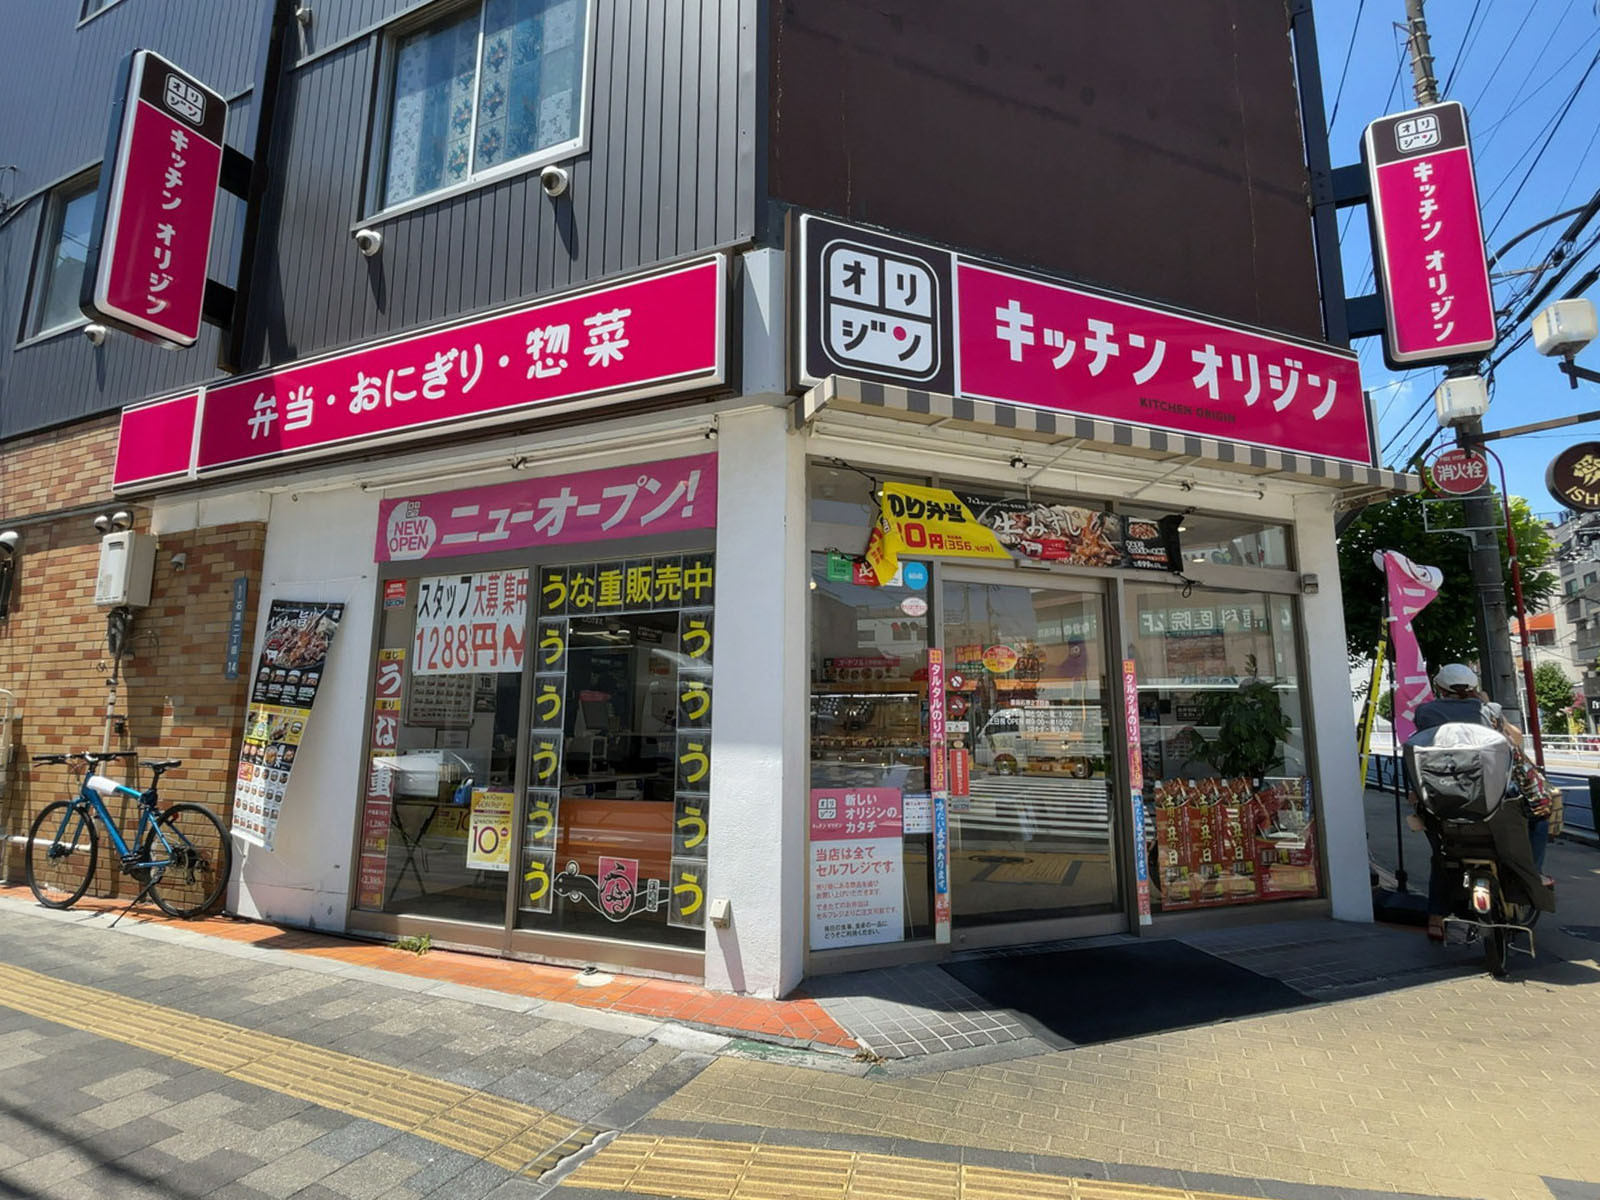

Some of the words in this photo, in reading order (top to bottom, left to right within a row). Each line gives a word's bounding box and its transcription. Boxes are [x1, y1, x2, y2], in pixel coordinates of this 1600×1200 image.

[161, 129, 190, 211] キッチン
[1412, 161, 1443, 242] キッチン
[146, 222, 177, 315] オリジン
[1424, 250, 1455, 342] オリジン
[995, 299, 1166, 386] キッチン
[1190, 344, 1337, 421] オリジン
[1139, 398, 1193, 415] KITCHEN
[1196, 408, 1236, 424] ORIGIN
[1436, 461, 1485, 482] 消火栓
[1565, 485, 1600, 505] ISH
[390, 535, 429, 552] OPEN
[394, 519, 428, 537] NEW
[542, 561, 713, 610] うな重販売中
[540, 629, 564, 665] う
[682, 620, 711, 658] う
[536, 684, 561, 721] う
[681, 681, 711, 720] う
[533, 742, 558, 780] う
[680, 743, 709, 783] う
[845, 794, 877, 806] 新しい
[845, 807, 897, 820] オリジンの
[529, 801, 554, 839] う
[677, 806, 707, 848] う
[845, 821, 877, 833] カタチ
[816, 847, 876, 862] 当店は全て
[524, 861, 550, 900] う
[673, 872, 704, 916] う
